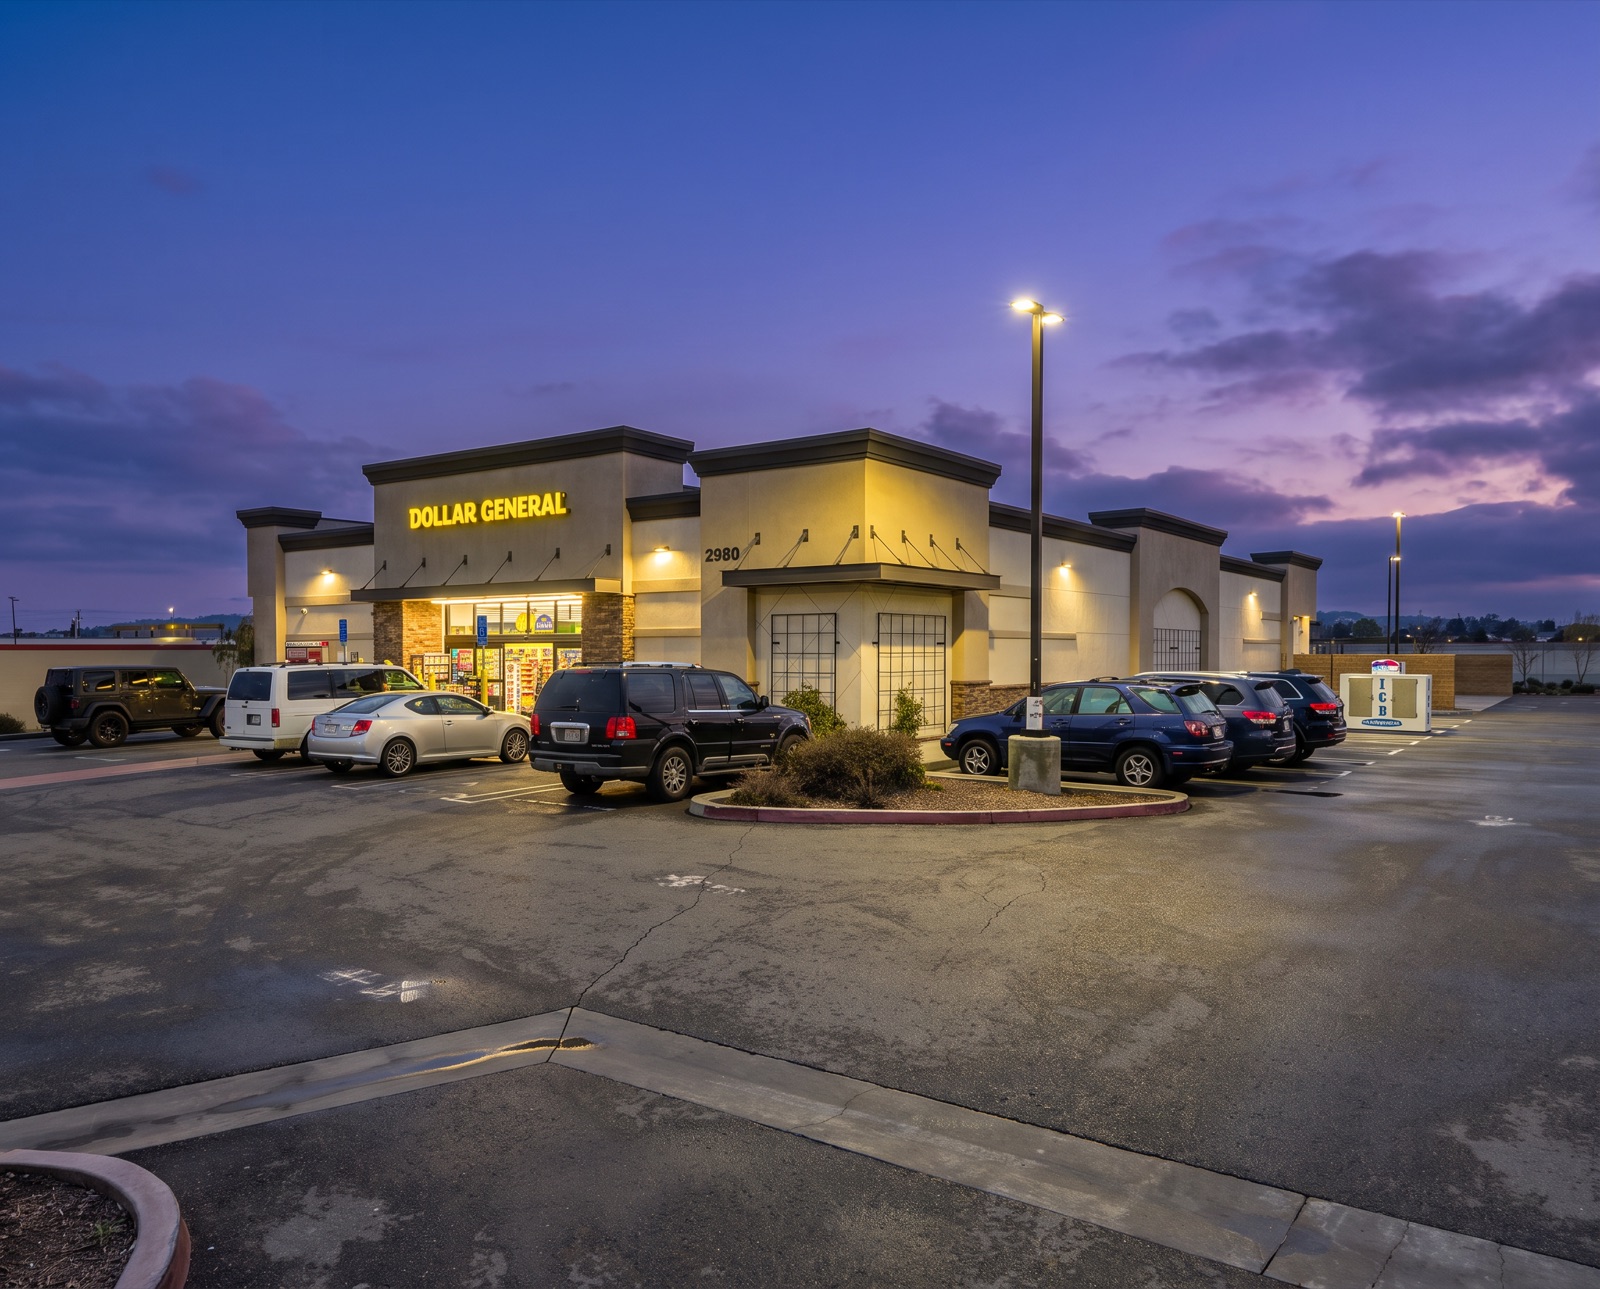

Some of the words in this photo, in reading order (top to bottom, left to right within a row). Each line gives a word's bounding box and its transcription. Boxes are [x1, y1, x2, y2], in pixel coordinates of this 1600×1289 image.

[409, 502, 477, 529] DOLLAR
[481, 492, 567, 521] GENERAL
[705, 547, 740, 562] 2980
